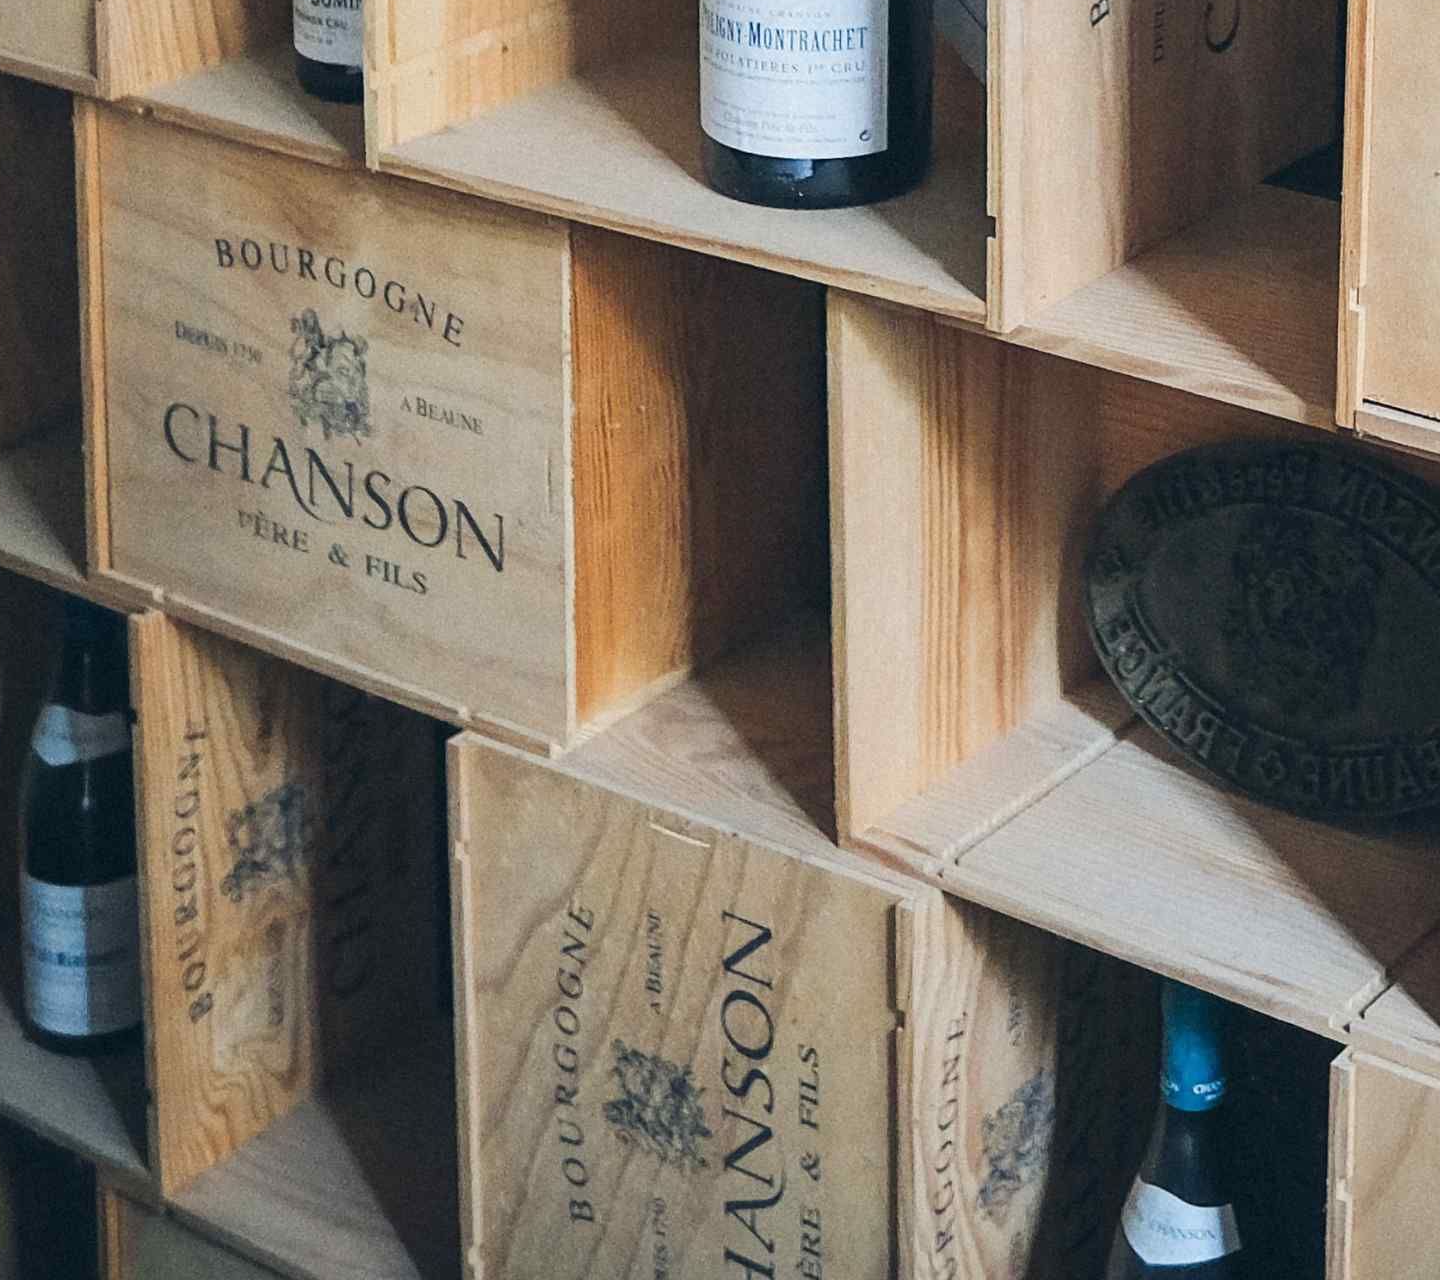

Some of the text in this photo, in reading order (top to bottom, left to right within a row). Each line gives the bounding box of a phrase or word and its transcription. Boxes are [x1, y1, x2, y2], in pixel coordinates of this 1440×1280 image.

[213, 237, 468, 349] BOURGOGNE
[414, 395, 485, 437] BEAUNE
[163, 401, 509, 575] CHANSON
[326, 542, 351, 570] &
[363, 551, 429, 597] FILS
[168, 717, 217, 1027] BOURGOGNE
[645, 908, 663, 995] BEAUNE
[553, 903, 597, 1227] BOURGOGNE
[796, 1044, 823, 1280] ÈRE & FILS
